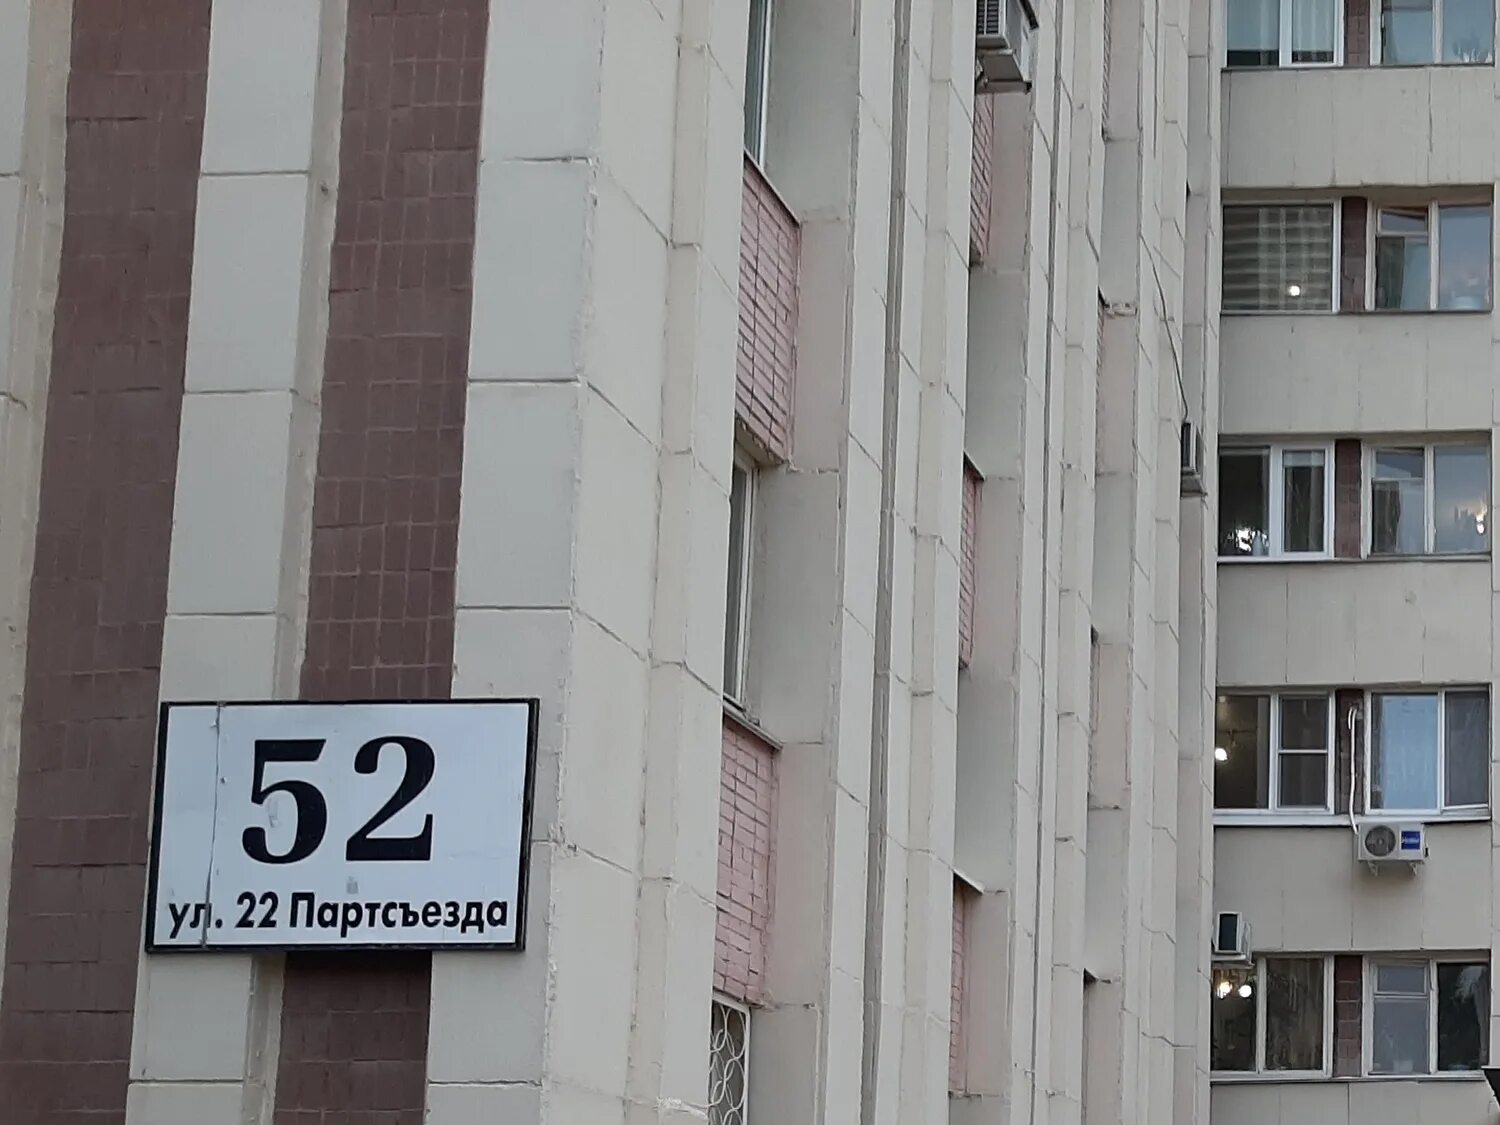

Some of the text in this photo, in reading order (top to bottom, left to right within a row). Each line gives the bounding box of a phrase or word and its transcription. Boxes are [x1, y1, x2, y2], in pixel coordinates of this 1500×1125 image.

[242, 736, 436, 864] 52
[168, 892, 508, 939] ул. 22 Партсъезда
